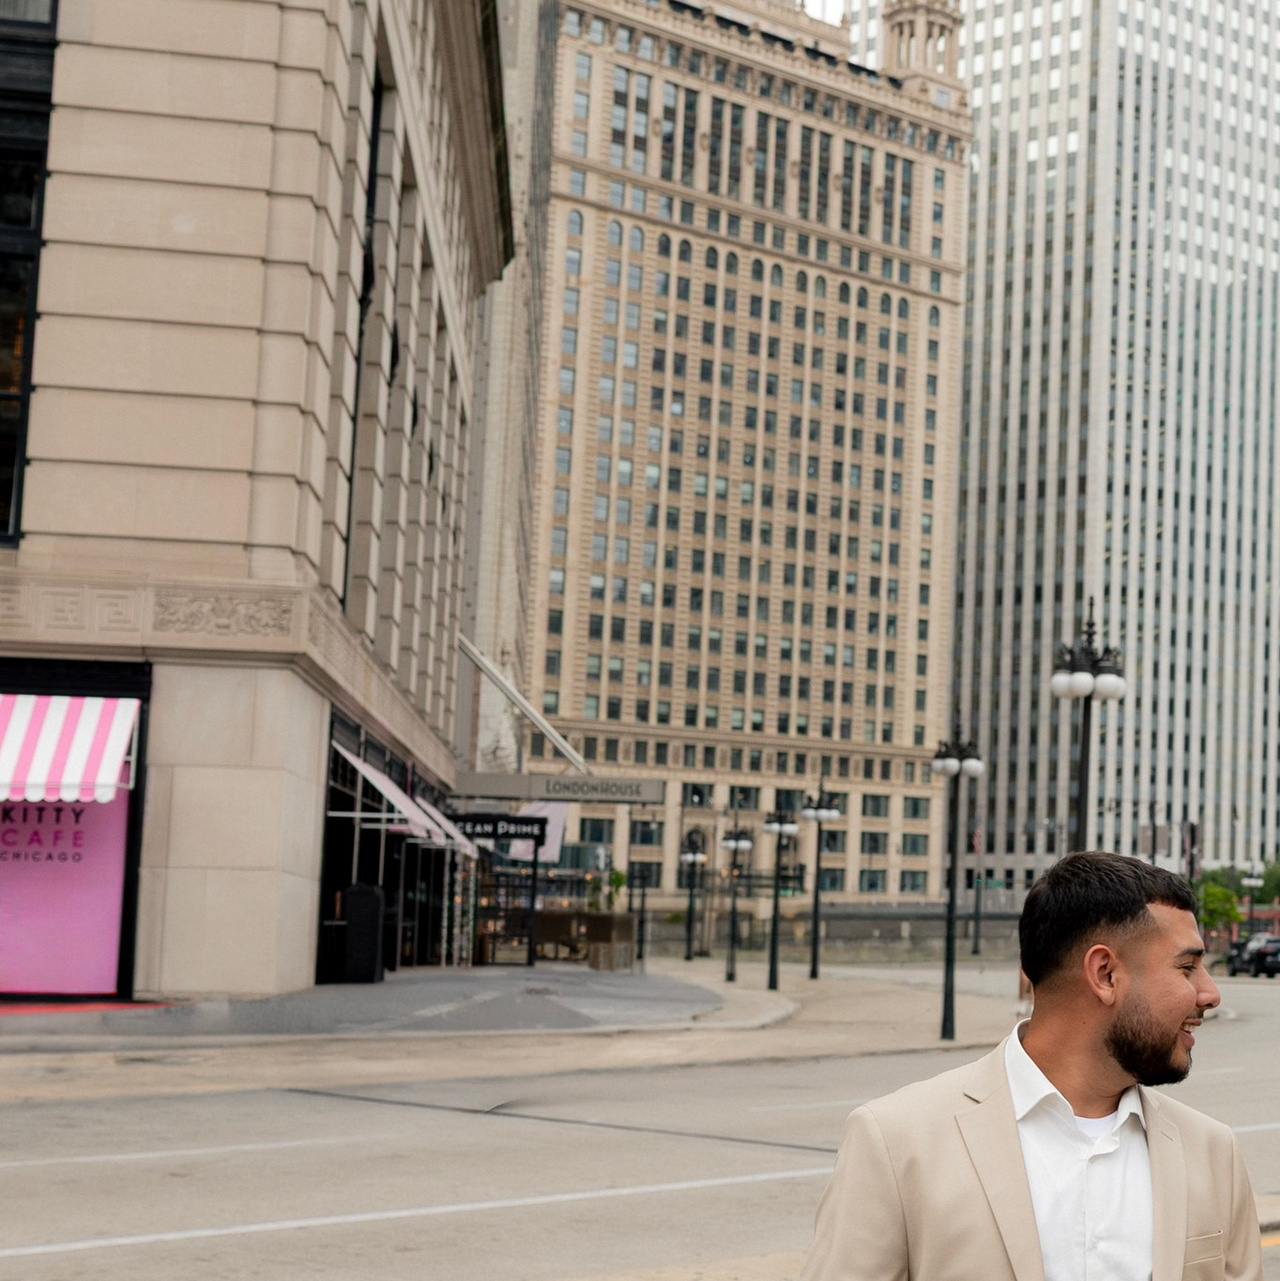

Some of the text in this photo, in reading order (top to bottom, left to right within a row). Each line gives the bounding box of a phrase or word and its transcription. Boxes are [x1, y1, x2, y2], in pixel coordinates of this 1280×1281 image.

[2, 806, 85, 824] KITTY
[452, 821, 541, 835] CEAN PRIME
[1, 828, 83, 847] CAFE
[0, 850, 82, 862] CHICAGO
